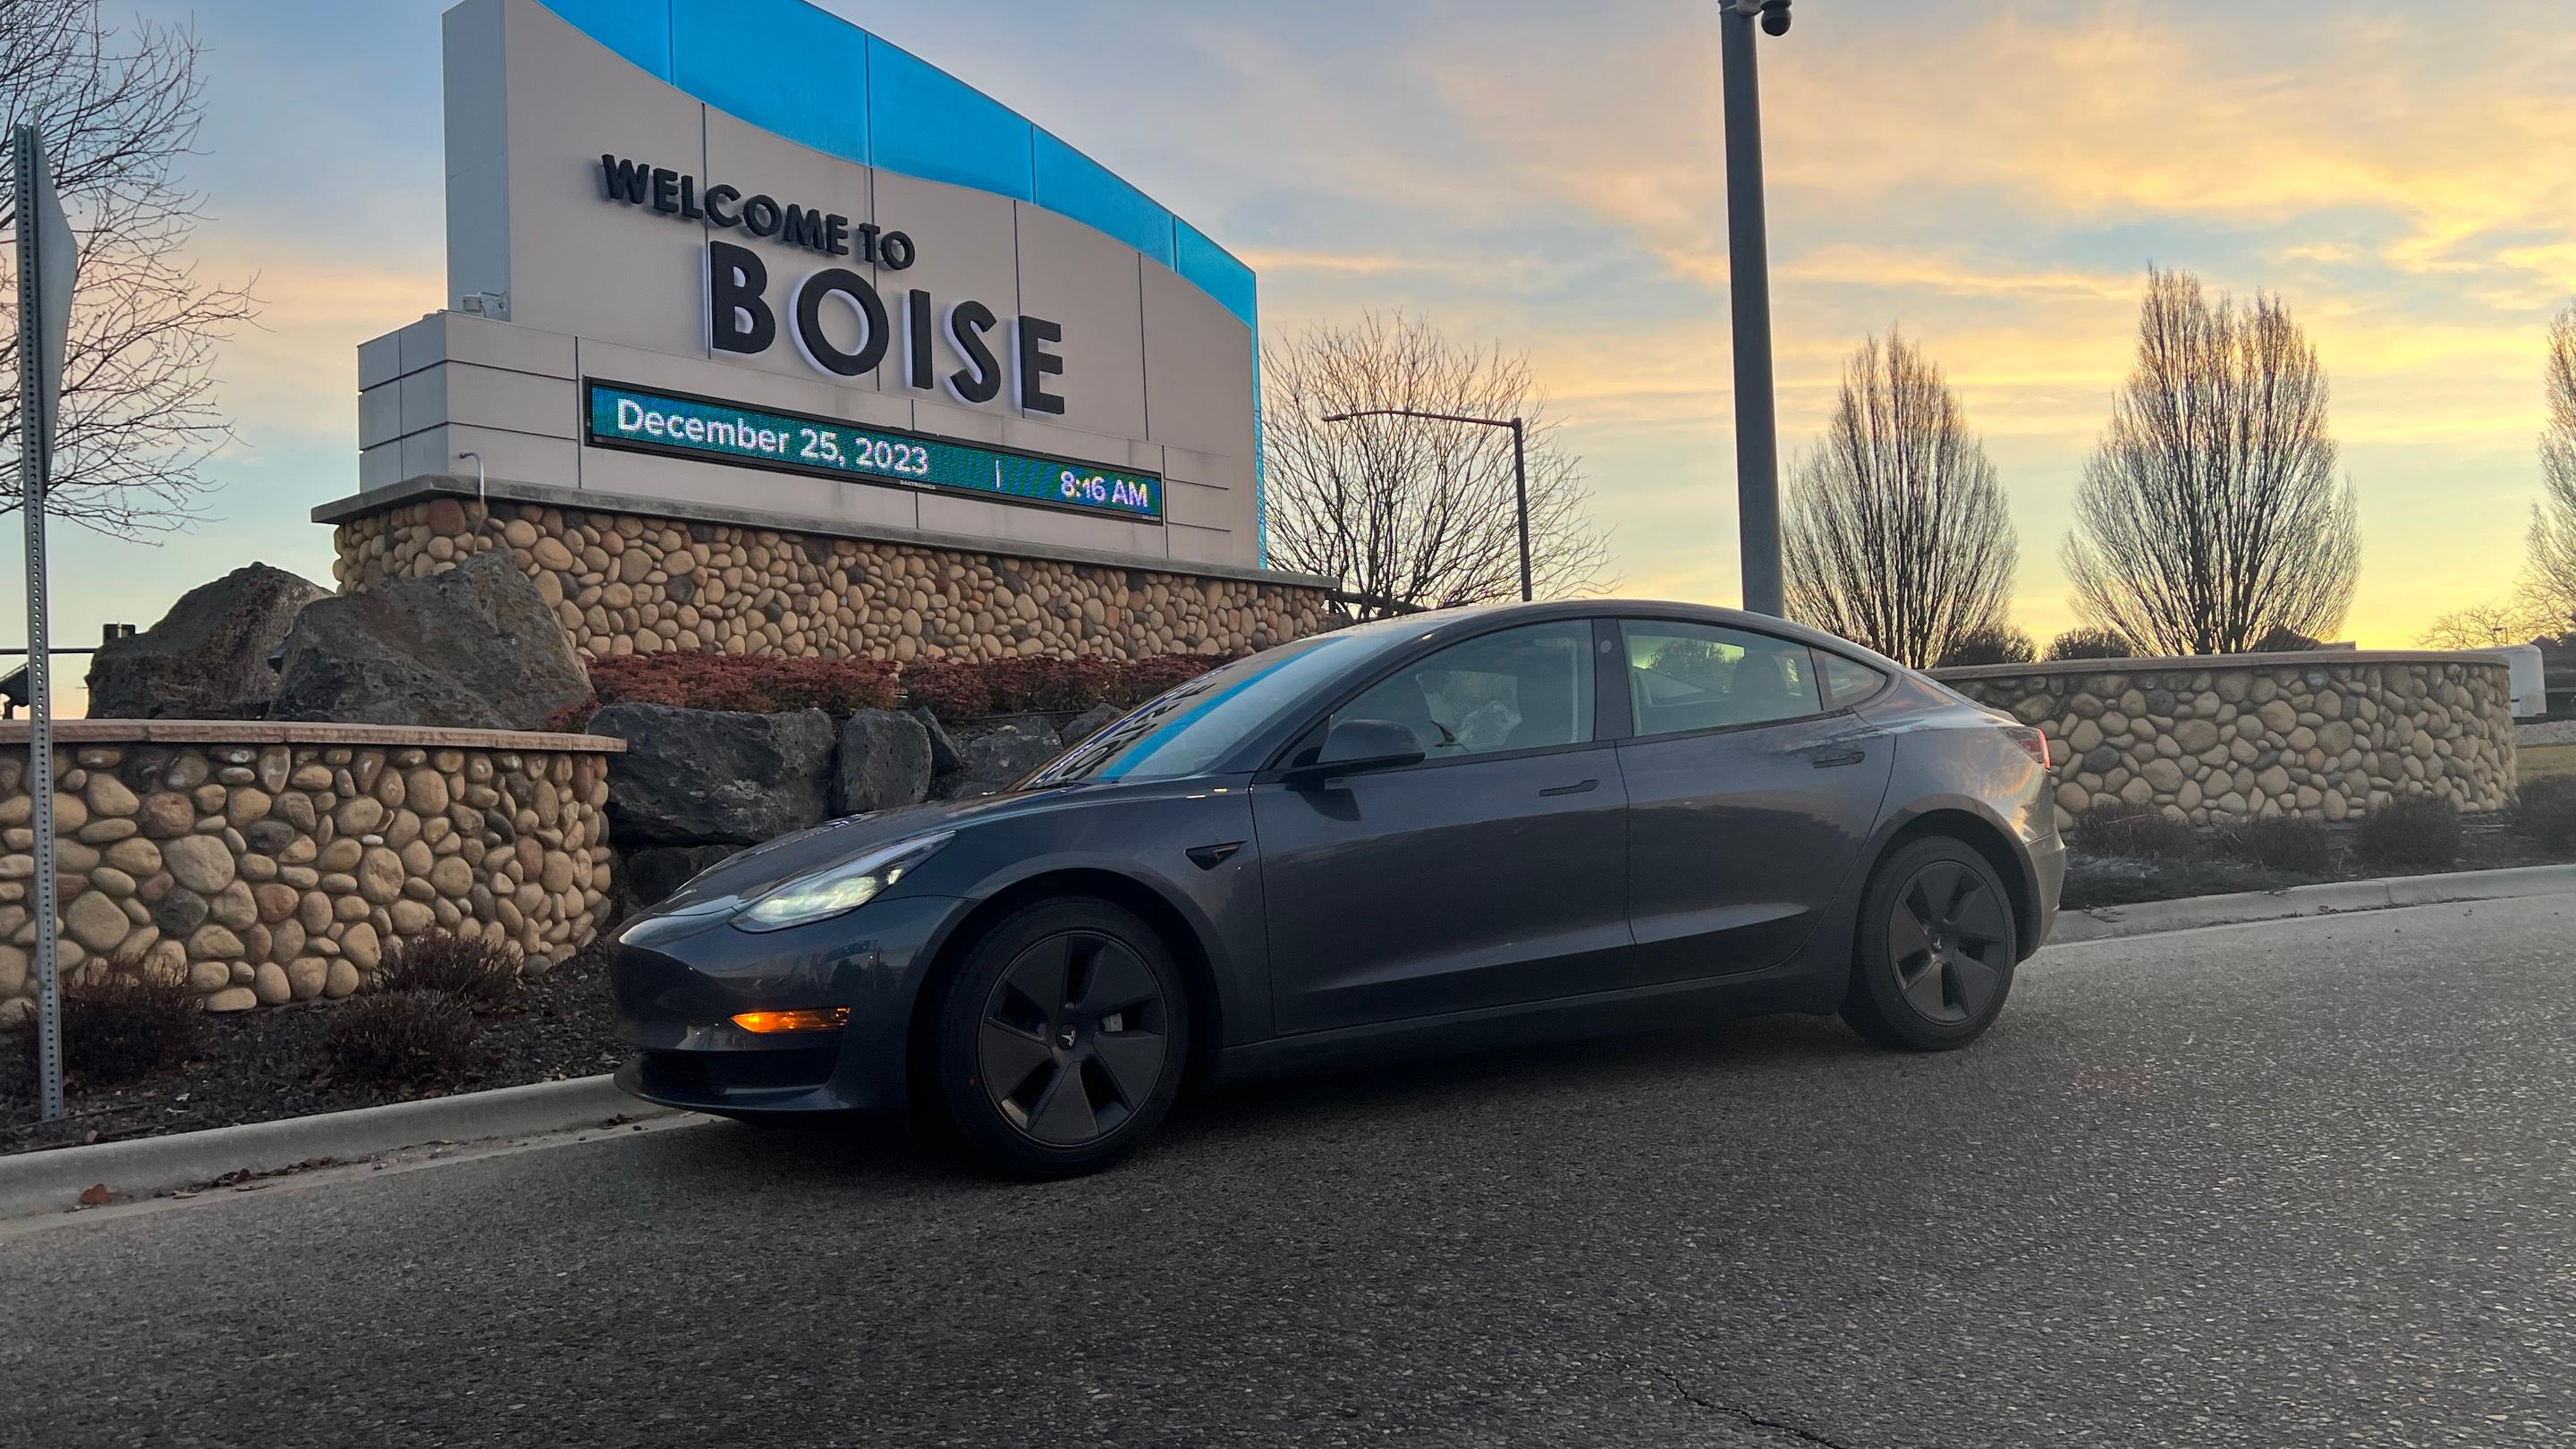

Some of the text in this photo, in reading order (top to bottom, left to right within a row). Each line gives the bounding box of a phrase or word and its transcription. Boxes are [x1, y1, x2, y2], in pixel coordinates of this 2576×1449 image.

[601, 153, 916, 270] WELCOME TO
[709, 240, 1065, 415] BOISE
[617, 398, 929, 476] December 25, 2023
[1060, 470, 1148, 508] 8:16 AM
